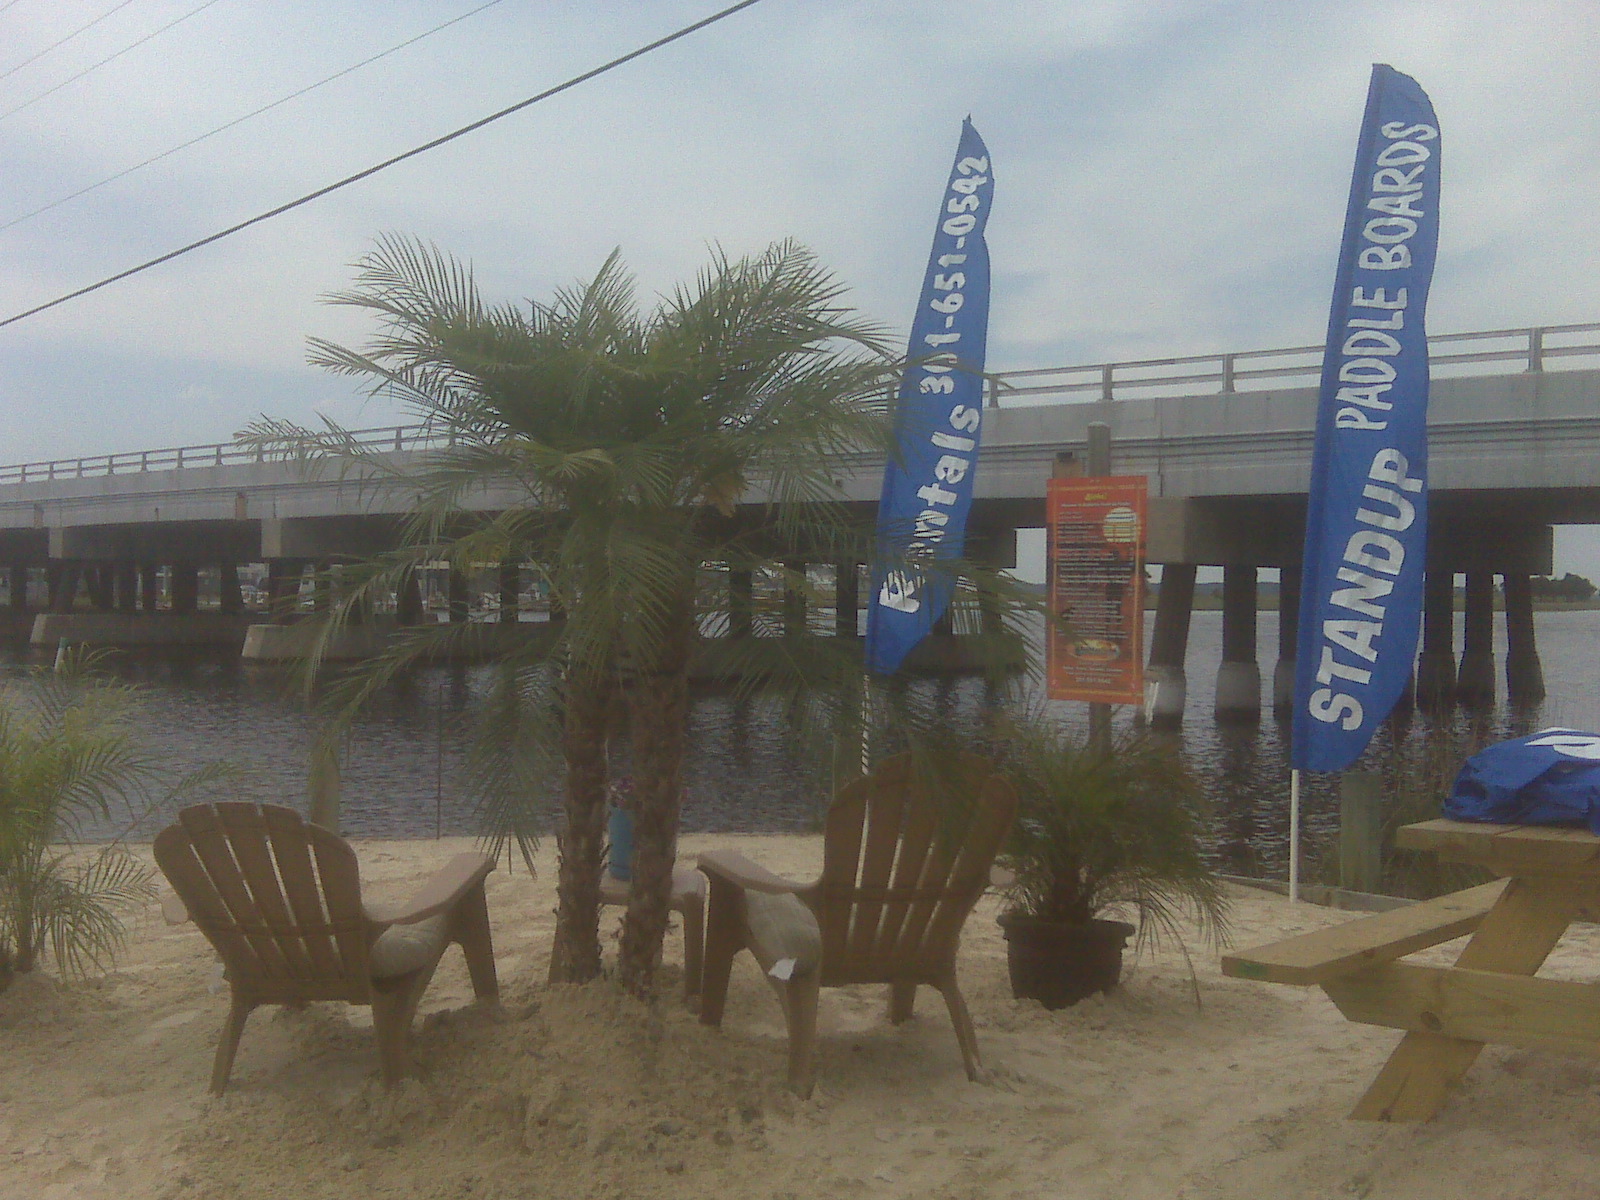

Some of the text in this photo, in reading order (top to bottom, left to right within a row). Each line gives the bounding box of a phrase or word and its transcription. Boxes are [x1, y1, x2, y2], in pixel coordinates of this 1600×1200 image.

[919, 155, 989, 395] 301-651-0542
[1308, 121, 1439, 732] STANDUP PADDLE BOARDS
